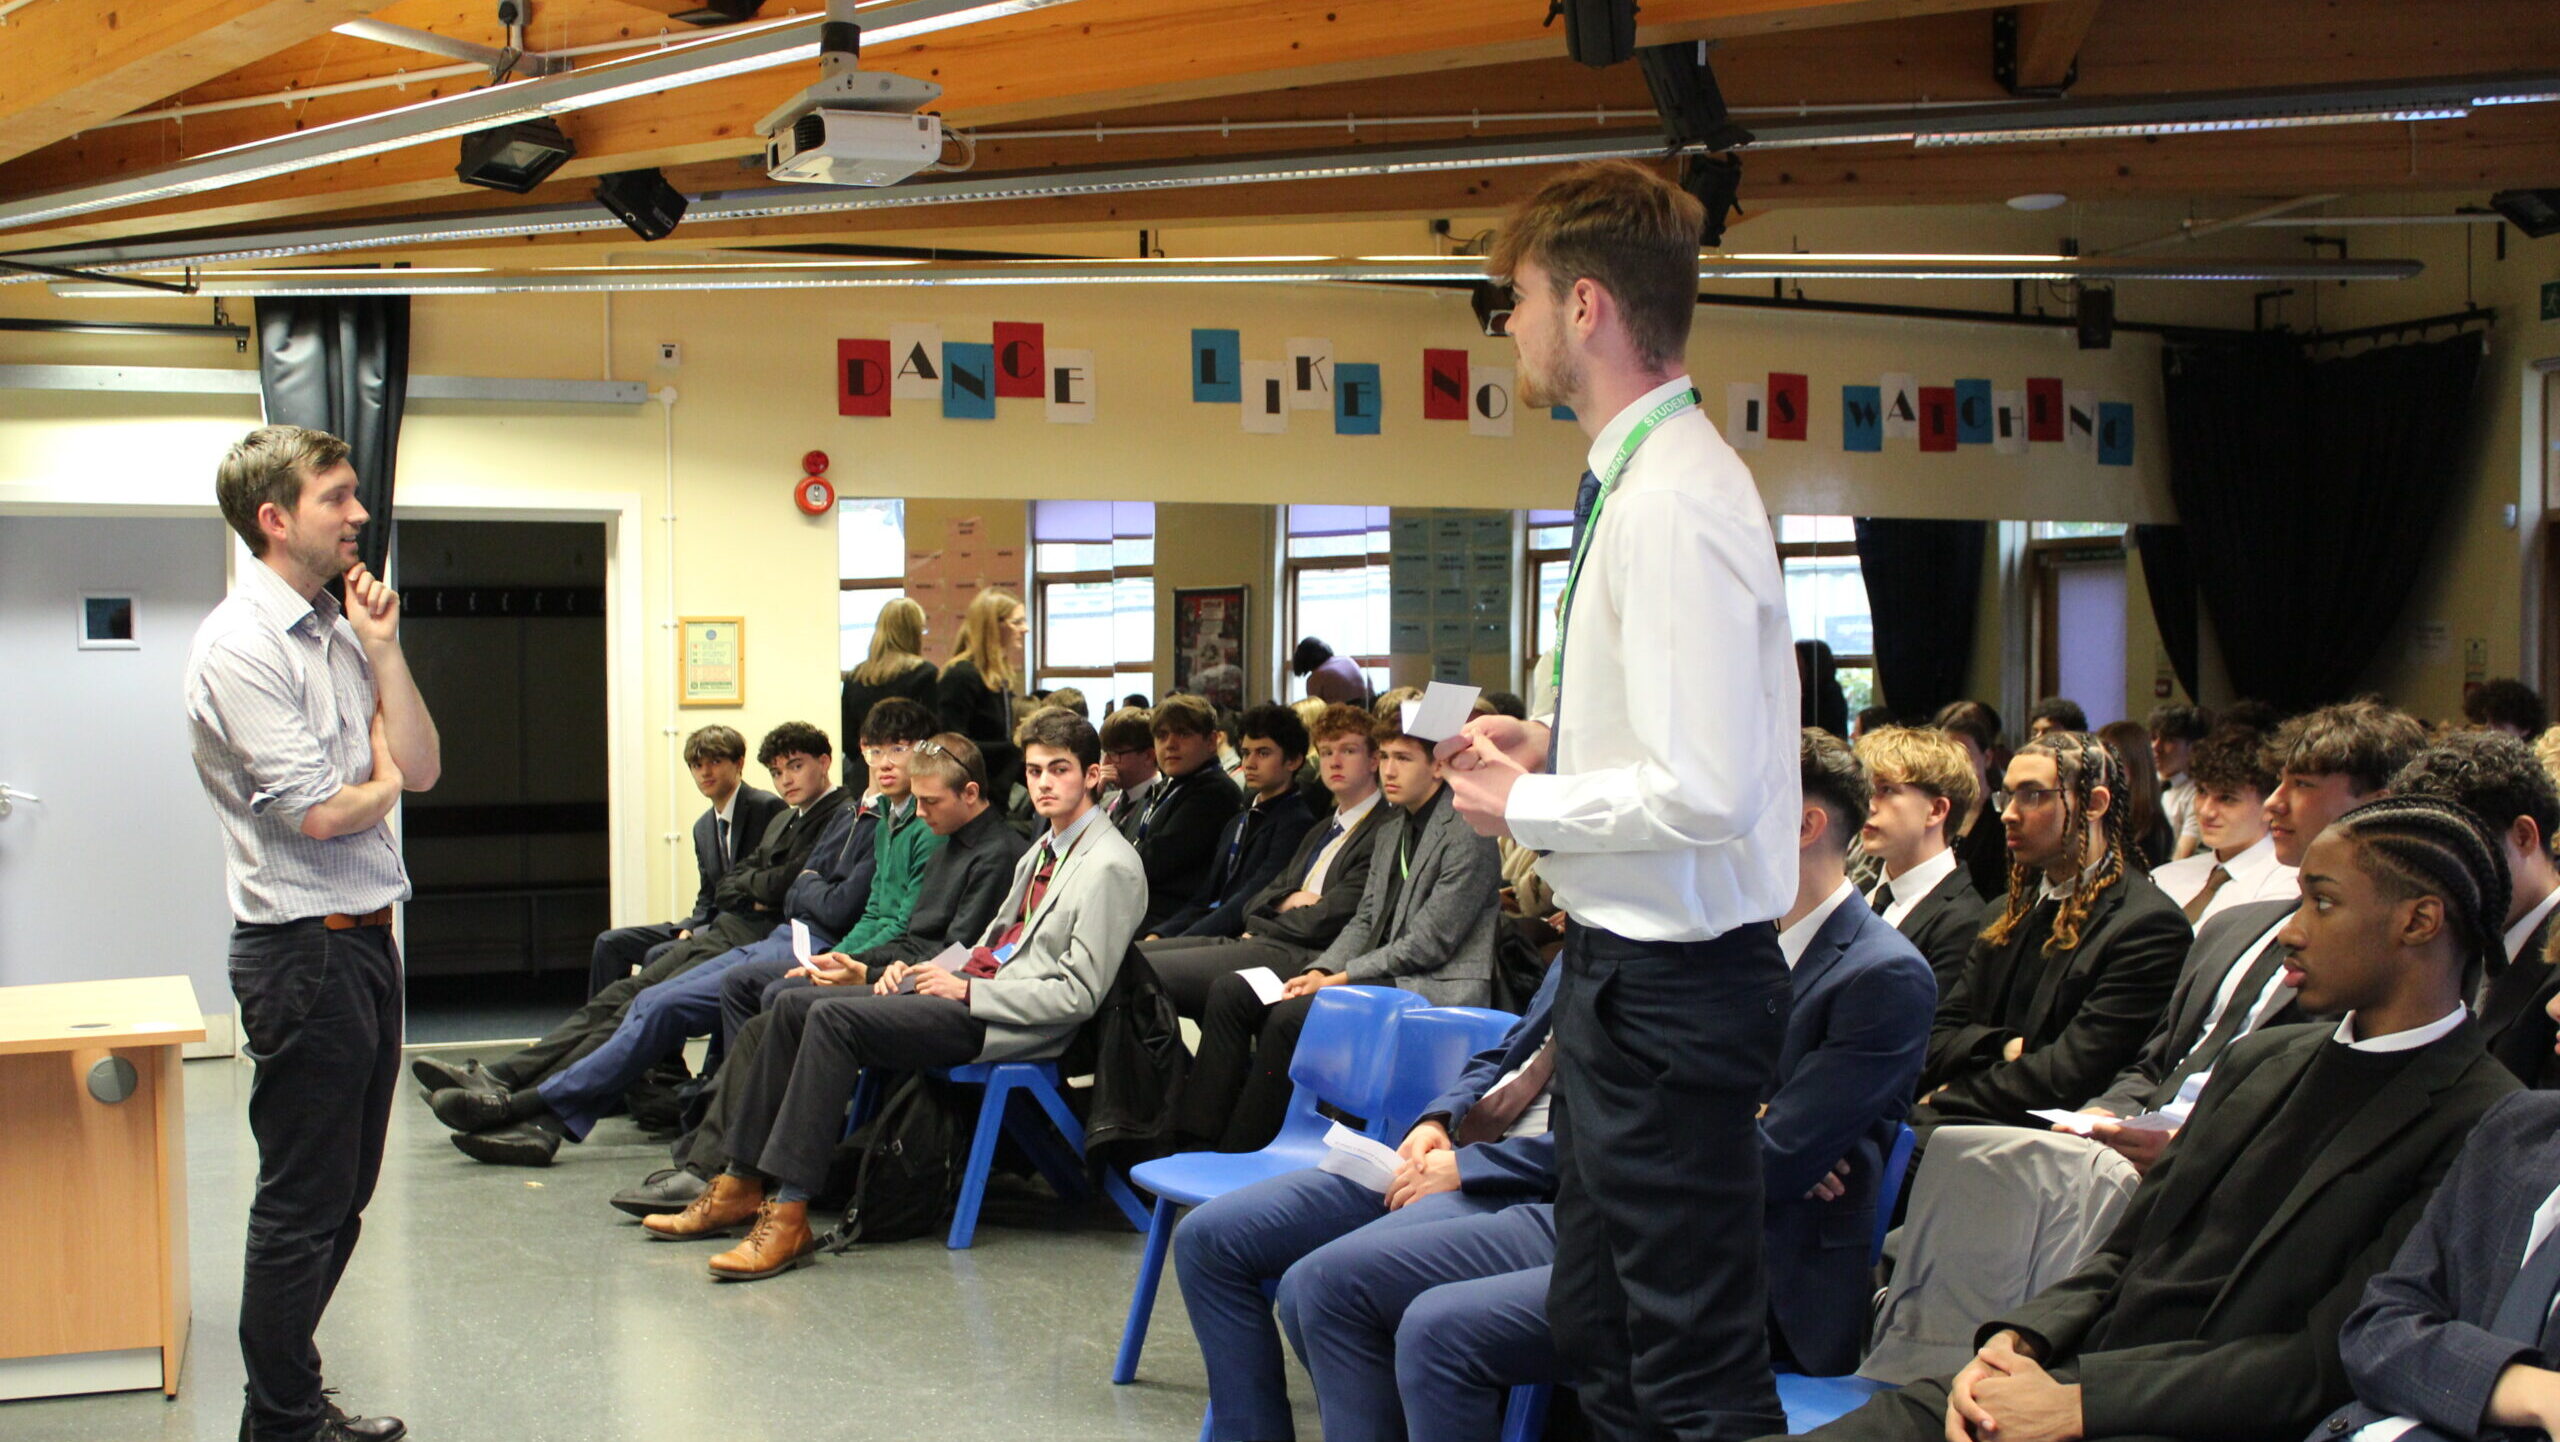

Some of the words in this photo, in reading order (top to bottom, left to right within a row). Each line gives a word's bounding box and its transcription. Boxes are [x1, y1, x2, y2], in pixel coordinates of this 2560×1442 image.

[847, 340, 1086, 404] DANCE
[1200, 348, 1372, 417] LIKE
[1431, 366, 1508, 420] NO
[1746, 389, 1796, 432] IS
[1643, 393, 1690, 427] STUDENT
[1599, 445, 1628, 501] STUDENT
